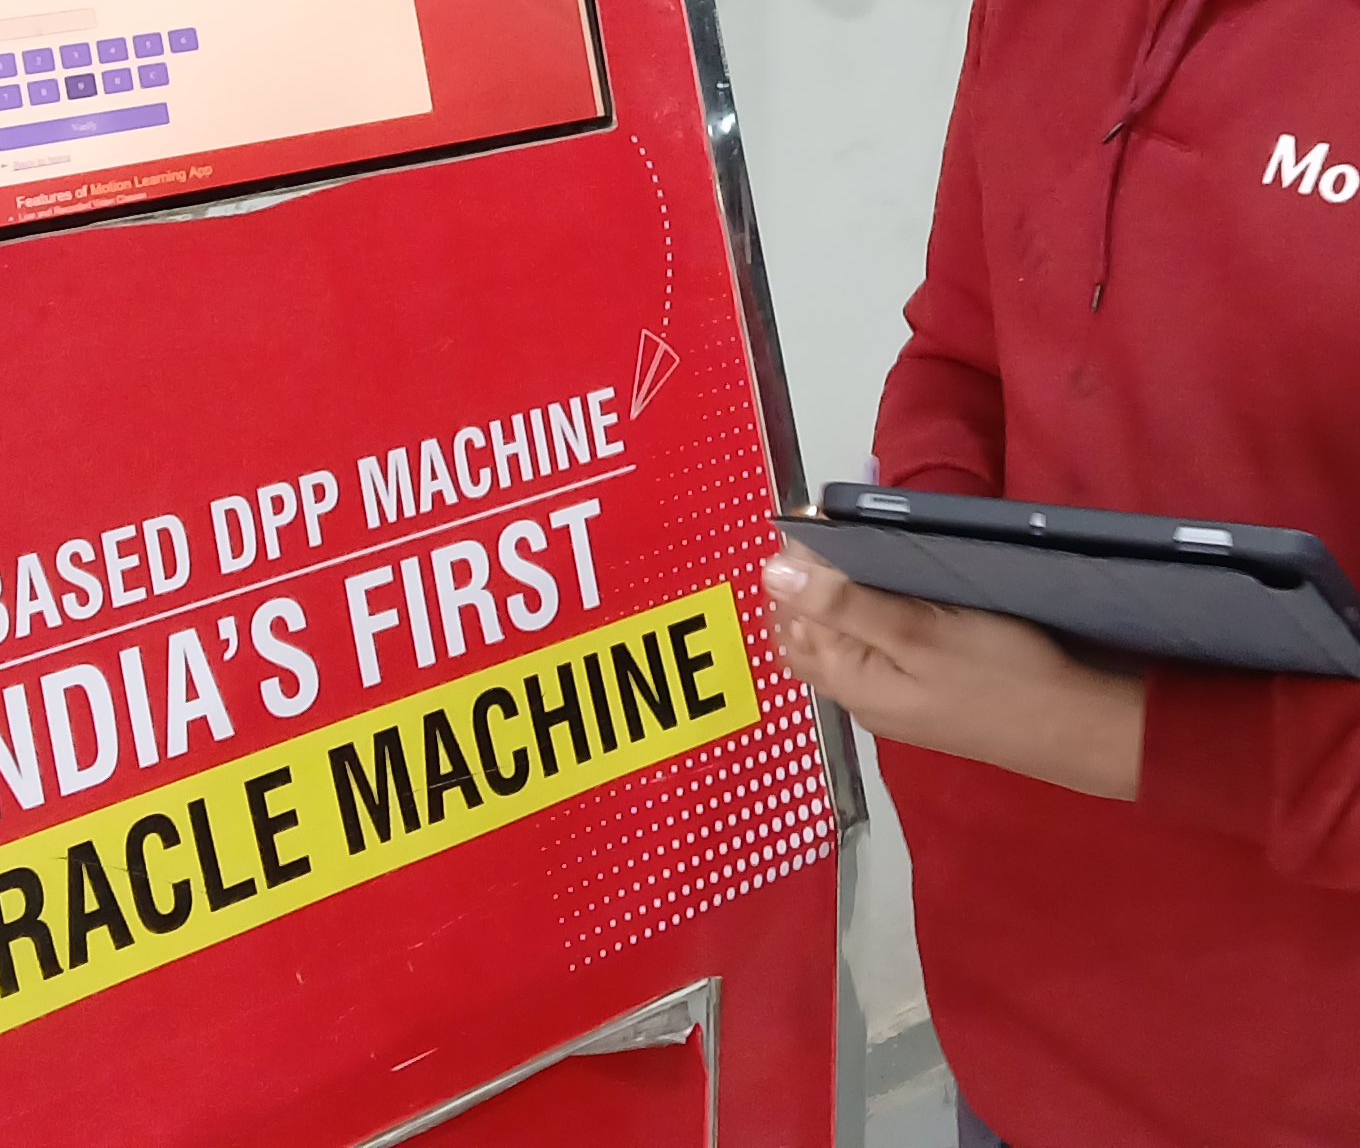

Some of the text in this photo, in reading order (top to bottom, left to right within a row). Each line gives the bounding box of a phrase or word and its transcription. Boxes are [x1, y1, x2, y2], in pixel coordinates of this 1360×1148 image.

[16, 165, 213, 209] Features of Motion Learning App
[211, 470, 339, 575] DPP
[359, 387, 625, 529] MACHINE
[345, 498, 605, 688] FIRST
[327, 613, 726, 856] MACHINE
